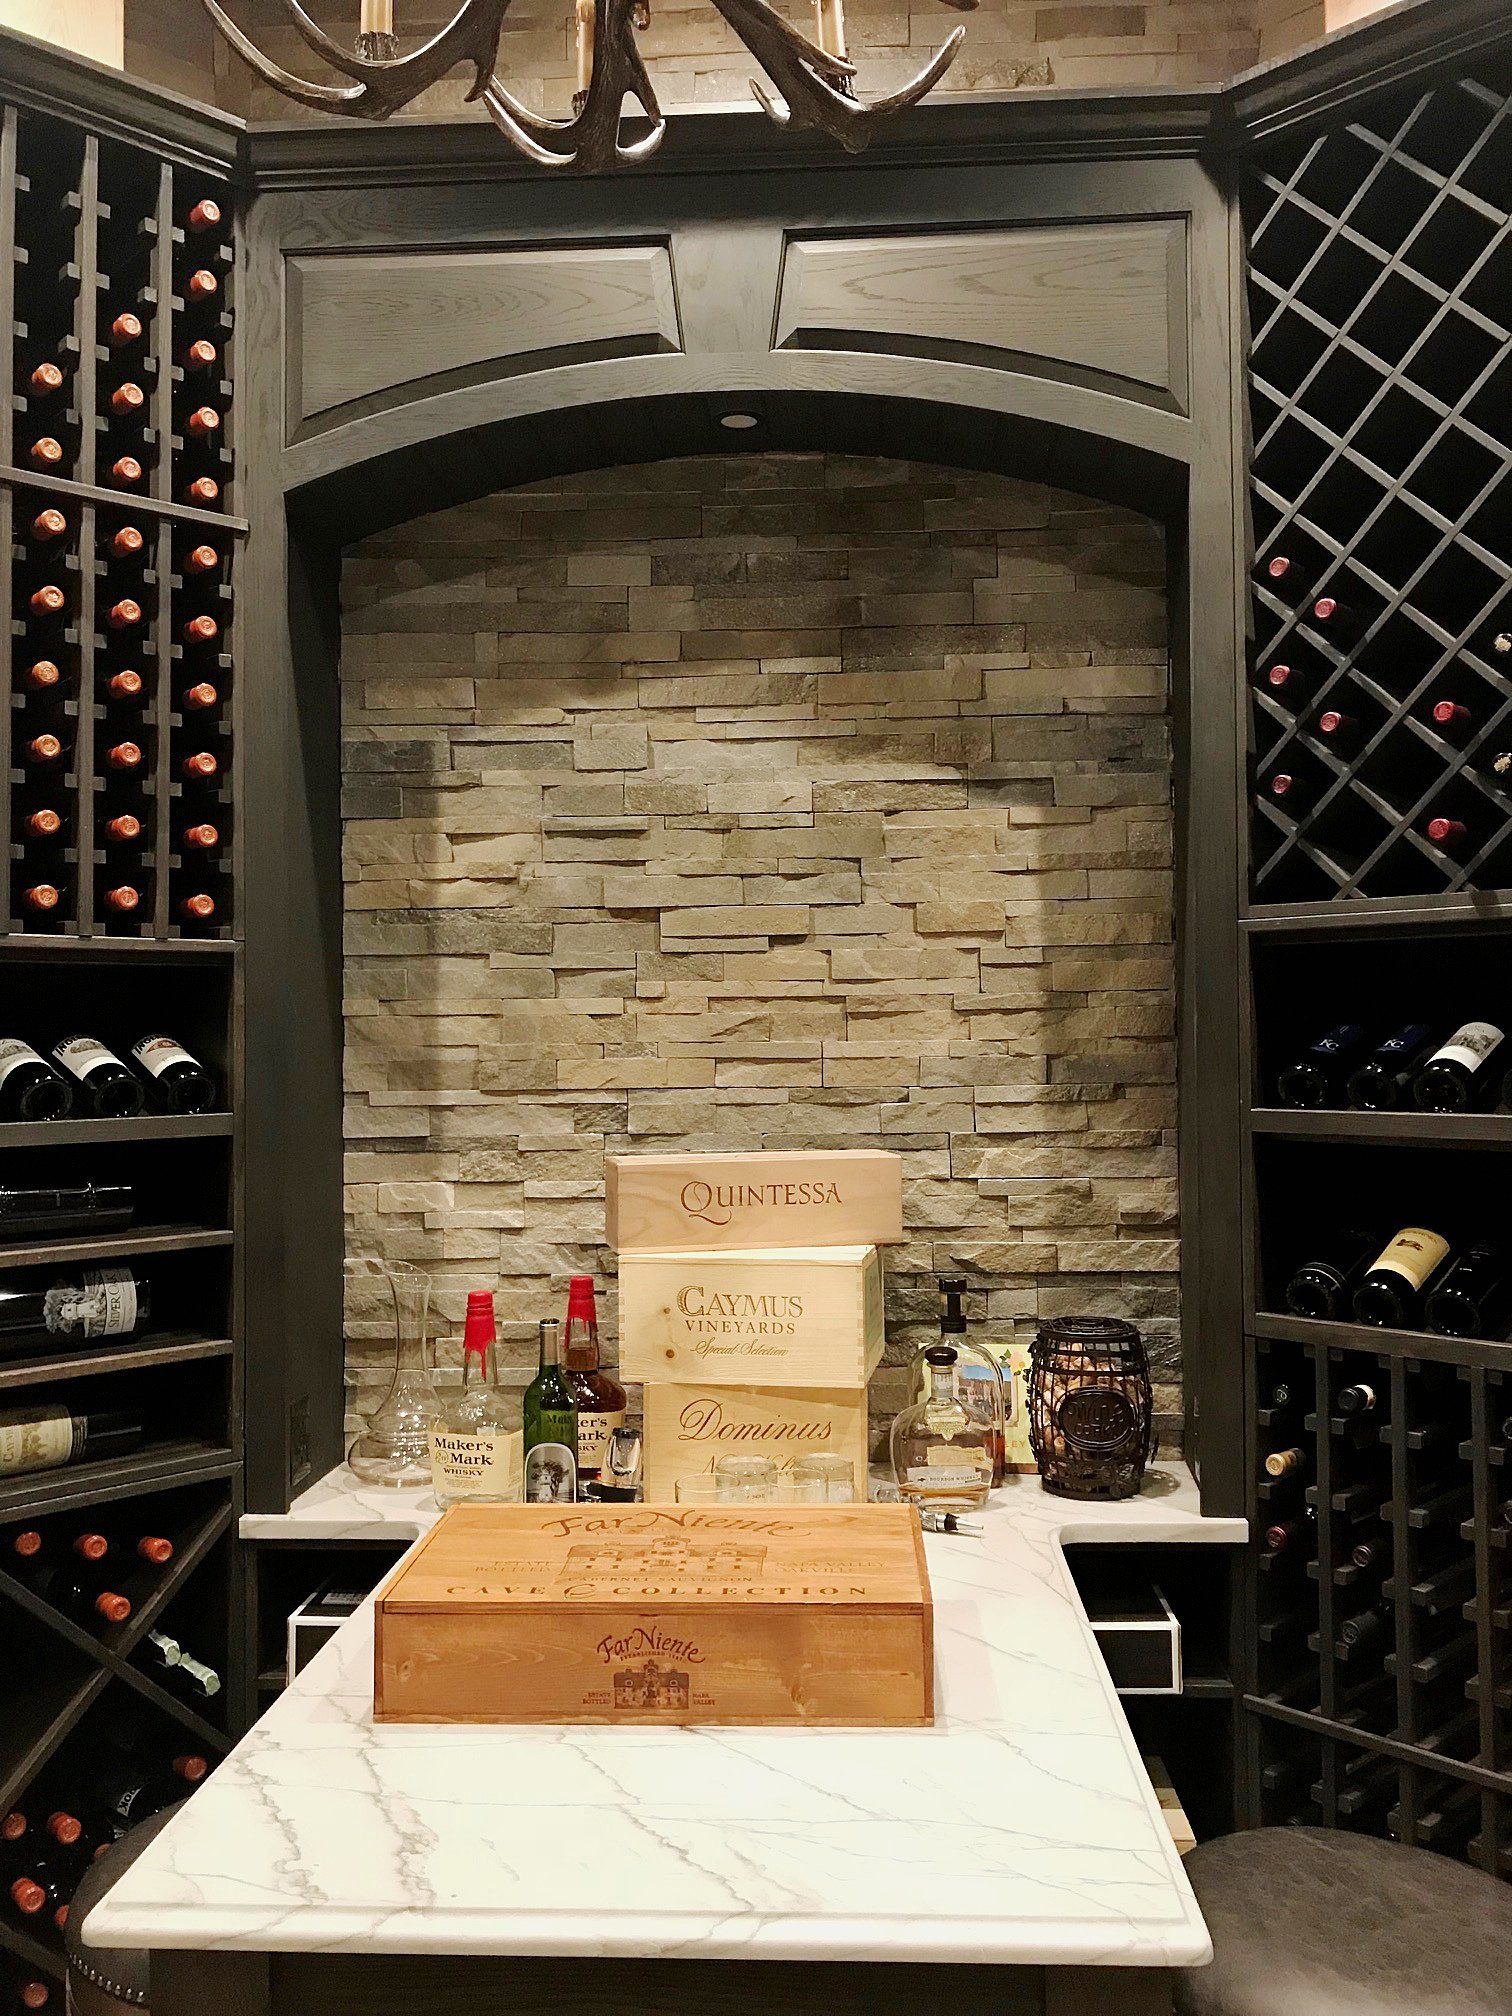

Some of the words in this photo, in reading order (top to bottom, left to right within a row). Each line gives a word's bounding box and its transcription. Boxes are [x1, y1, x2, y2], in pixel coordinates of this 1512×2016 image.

[681, 1180, 842, 1226] QUINTESSA
[109, 1296, 121, 1327] SILVER
[676, 1285, 803, 1318] CAYMUS
[685, 1320, 796, 1335] VINEYARDS
[690, 1336, 740, 1359] Special
[740, 1339, 790, 1357] Selection
[677, 1398, 832, 1441] Dominus
[434, 1437, 494, 1452] Maker's
[578, 1430, 608, 1441] ark
[450, 1453, 494, 1466] Mark
[443, 1467, 484, 1476] WHISKY
[541, 1516, 633, 1538] Far
[635, 1509, 811, 1538] Niente
[446, 1586, 547, 1595] CAVE
[612, 1586, 867, 1596] COLLECTION
[596, 1634, 633, 1664] Far
[632, 1625, 706, 1664] Niente
